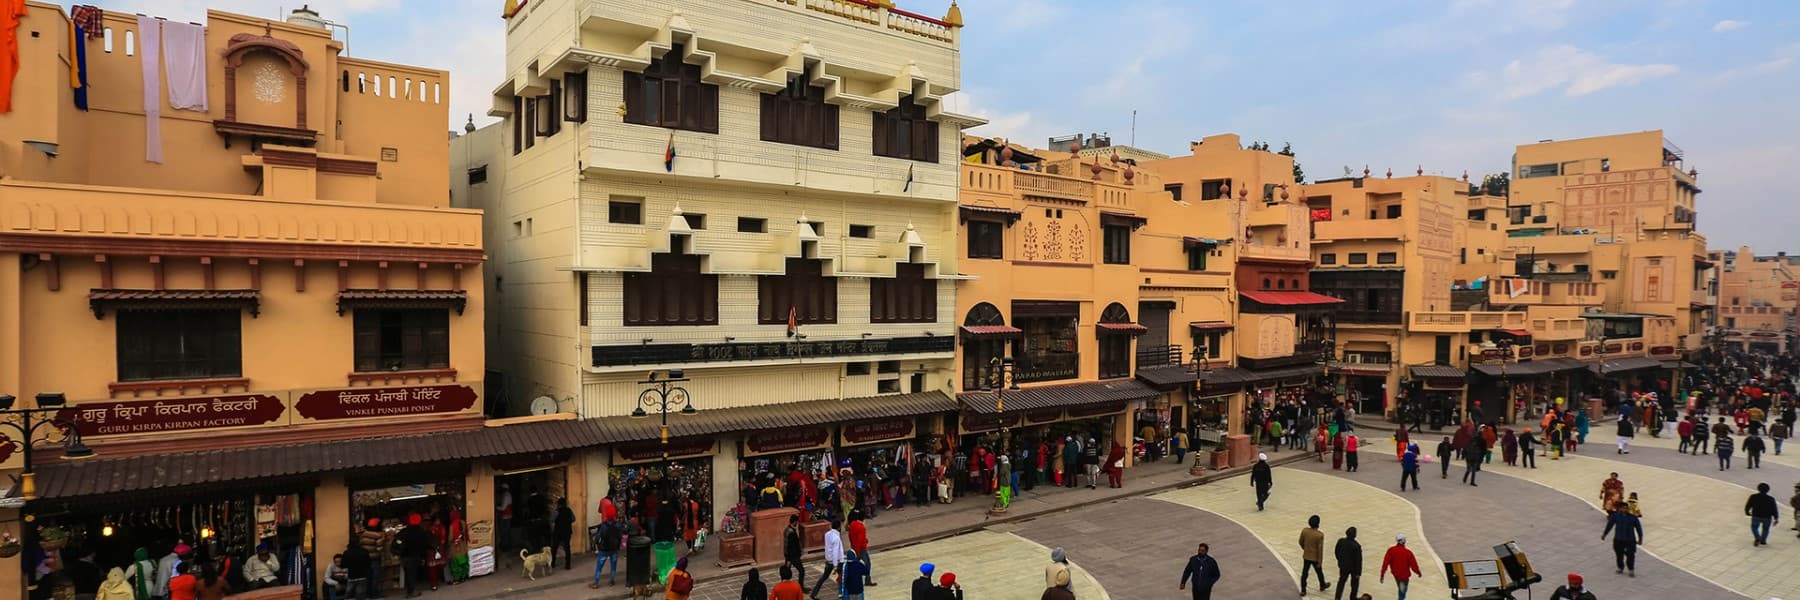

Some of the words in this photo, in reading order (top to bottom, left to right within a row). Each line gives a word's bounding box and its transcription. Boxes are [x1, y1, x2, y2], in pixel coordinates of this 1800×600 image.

[375, 389, 409, 402] ਪੰਜਾਬੀ
[82, 408, 108, 424] ਗੁਰੂ
[112, 403, 149, 420] ਕ੍ਰਿਪਾ
[153, 401, 208, 416] ਕਿਰਪਾਨ
[212, 396, 259, 412] ਫੈਕਟਰੀ
[377, 406, 409, 415] PUNJABI
[411, 404, 435, 413] POINT
[98, 424, 130, 433] GURU
[132, 422, 162, 432] KIRPA
[164, 420, 201, 430] KIRPAN
[203, 417, 246, 427] FACTORY
